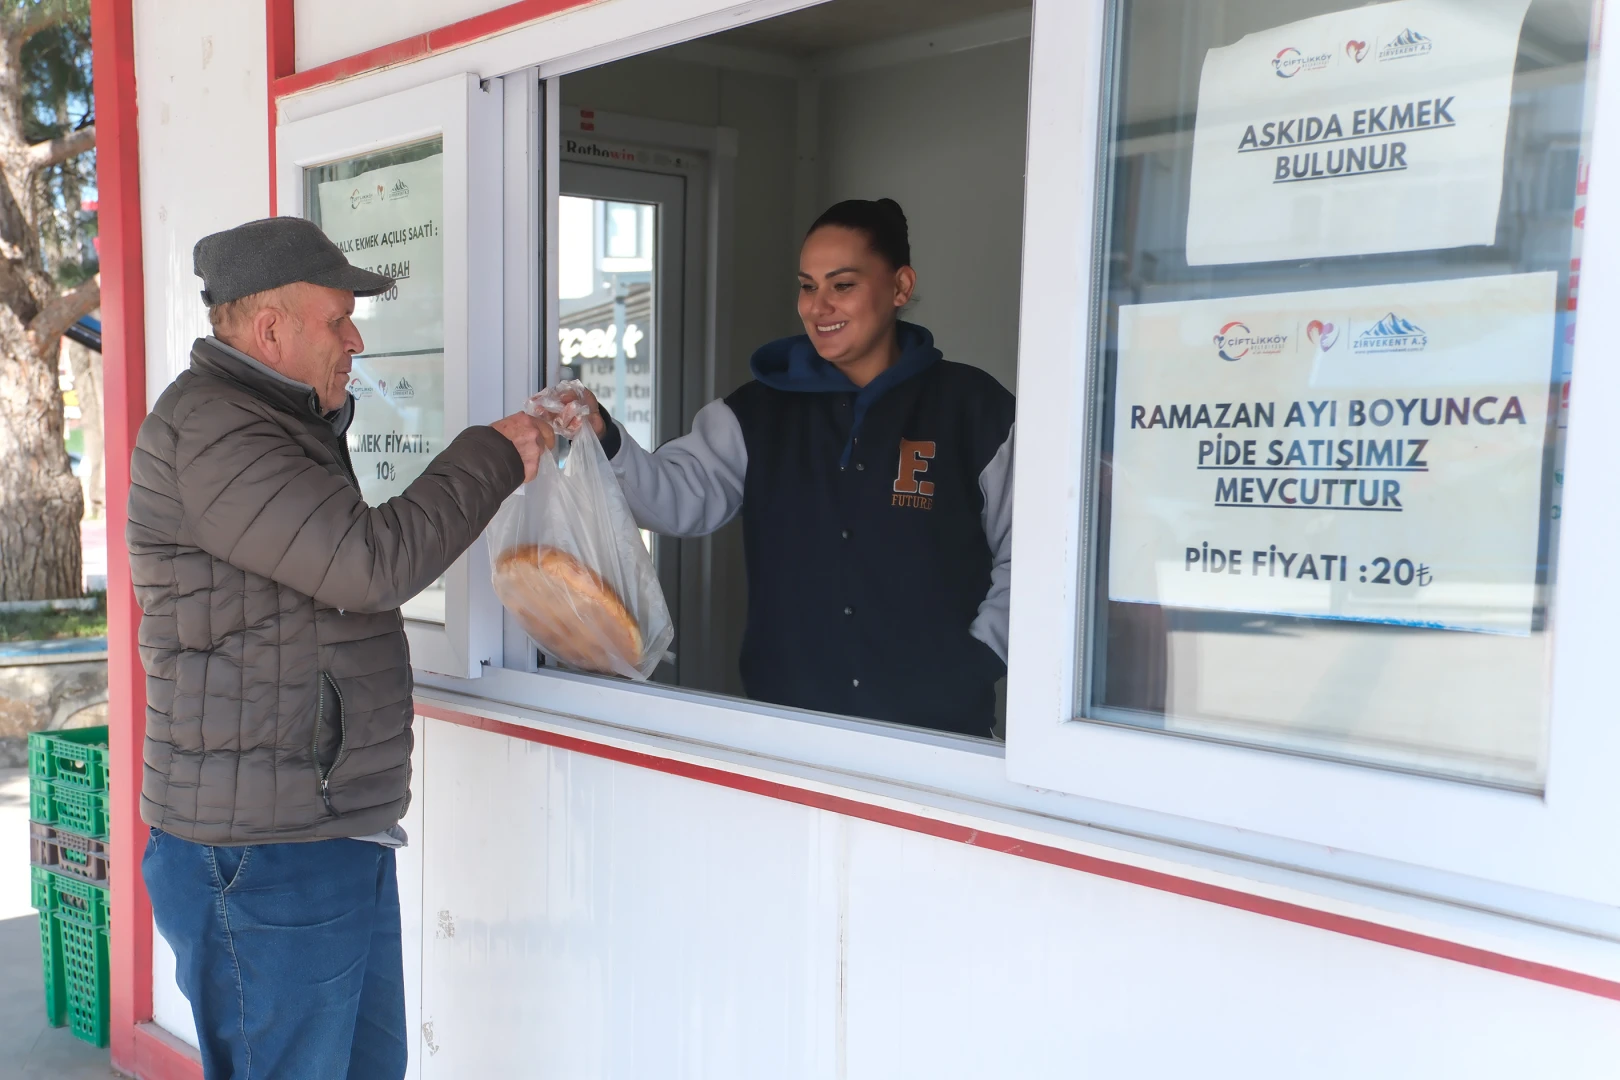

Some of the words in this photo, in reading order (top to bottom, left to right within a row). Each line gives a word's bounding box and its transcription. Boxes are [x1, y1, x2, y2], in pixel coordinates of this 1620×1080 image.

[1238, 113, 1343, 150] ASKIDA
[1352, 96, 1455, 135] EKMEK
[1274, 141, 1407, 180] BULUNUR
[355, 233, 379, 251] EKMEK
[381, 228, 406, 248] AÇILIŞ
[409, 220, 433, 241] SAATİ
[377, 260, 410, 279] SABAH
[1227, 335, 1288, 347] ÇİFTLİKKÖY
[1353, 338, 1407, 348] ZİRVEKENT
[1130, 402, 1275, 429] RAMAZAN
[1284, 400, 1336, 427] AYI
[1348, 396, 1527, 428] BOYUNCA
[385, 430, 423, 454] FİYATI
[1197, 432, 1257, 467] PİDE
[1266, 438, 1429, 470] SATIŞIMIZ
[891, 494, 933, 510] FUTURE
[1215, 477, 1403, 508] MEVCUTTUR
[1185, 541, 1242, 576] PİDE
[1252, 544, 1347, 582] FİYATI
